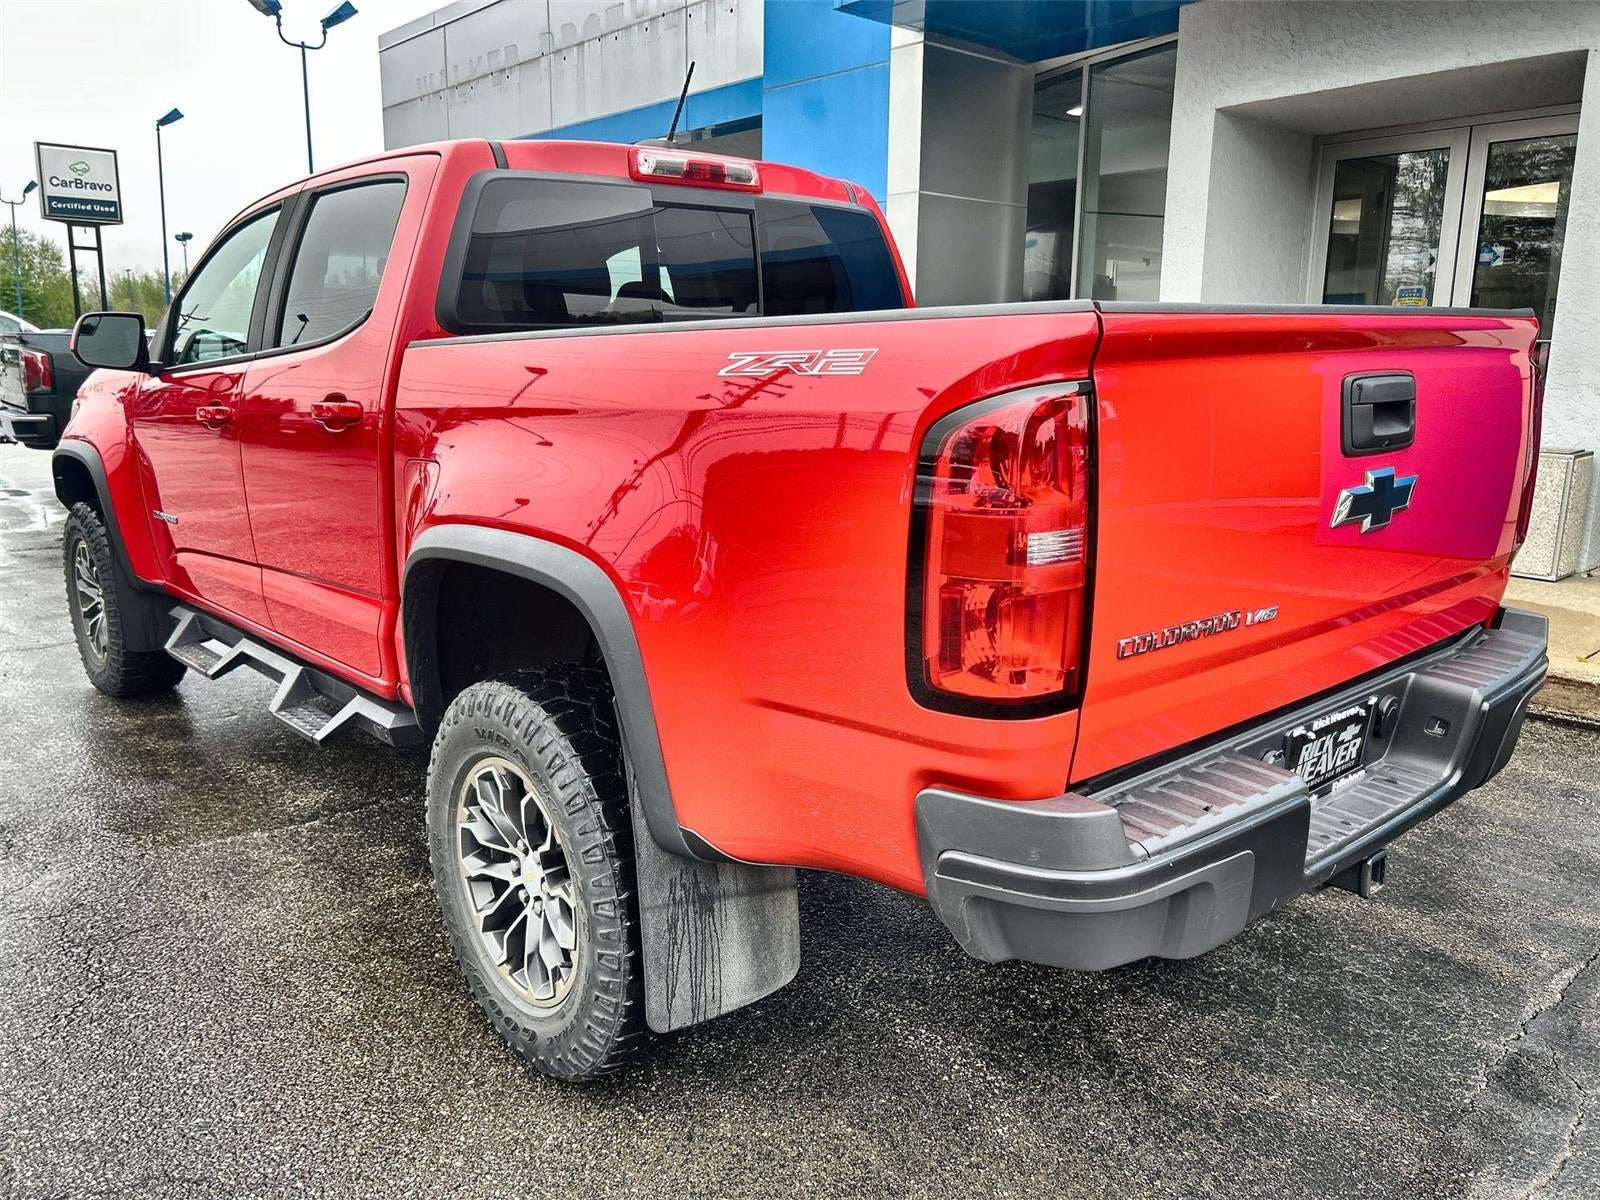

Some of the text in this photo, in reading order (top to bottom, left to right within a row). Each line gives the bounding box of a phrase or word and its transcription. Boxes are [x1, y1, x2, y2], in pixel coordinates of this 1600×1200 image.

[49, 176, 113, 192] CarBravo
[51, 200, 115, 213] Certified Used
[716, 348, 880, 377] ZR2
[1117, 610, 1242, 660] COLORADO
[1298, 731, 1338, 765] RICK
